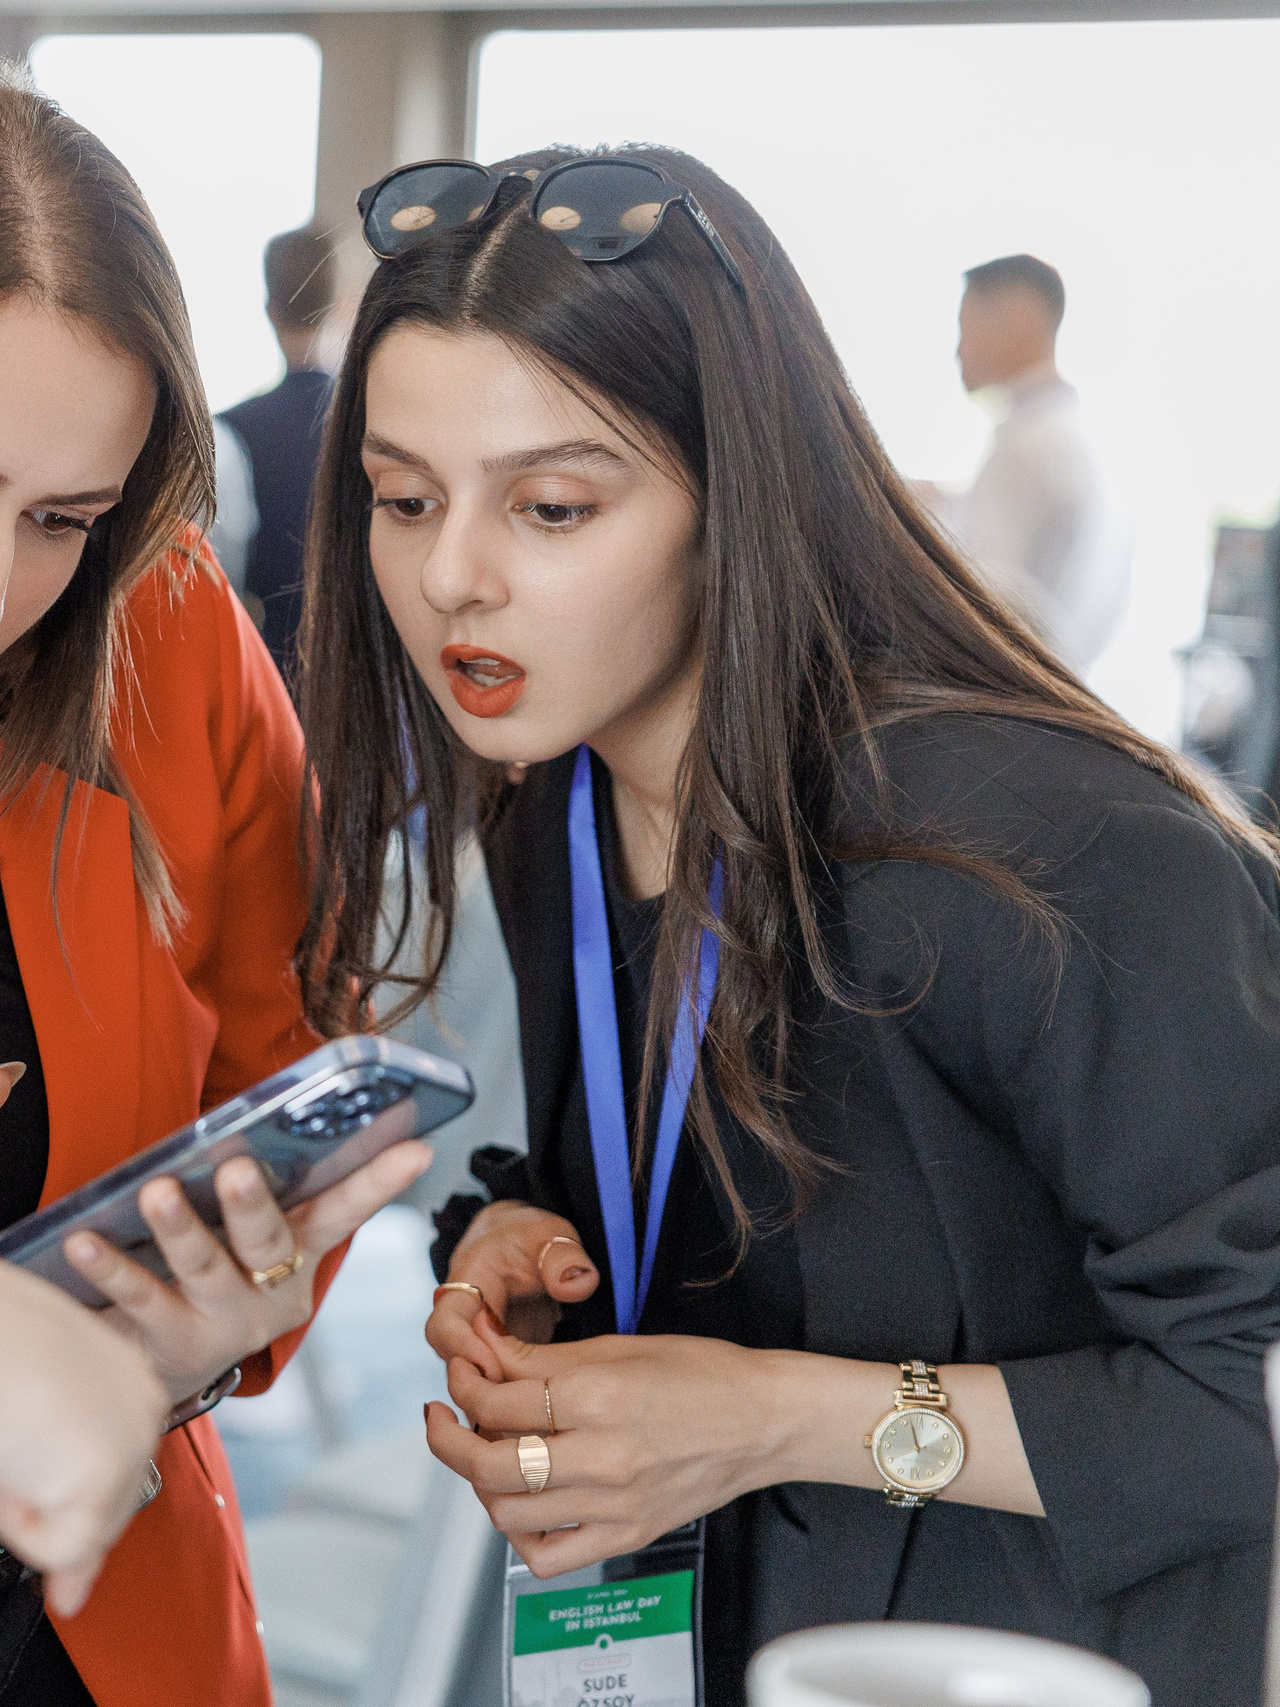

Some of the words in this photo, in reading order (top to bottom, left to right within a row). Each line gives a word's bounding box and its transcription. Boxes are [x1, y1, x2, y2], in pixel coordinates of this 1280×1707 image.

[548, 1604, 604, 1622] ENGLISH
[607, 1599, 634, 1613] LAW
[637, 1595, 662, 1609] DAY
[565, 1619, 580, 1632] IN
[583, 1611, 642, 1629] ISTANBUL
[583, 1673, 628, 1692] SUDE
